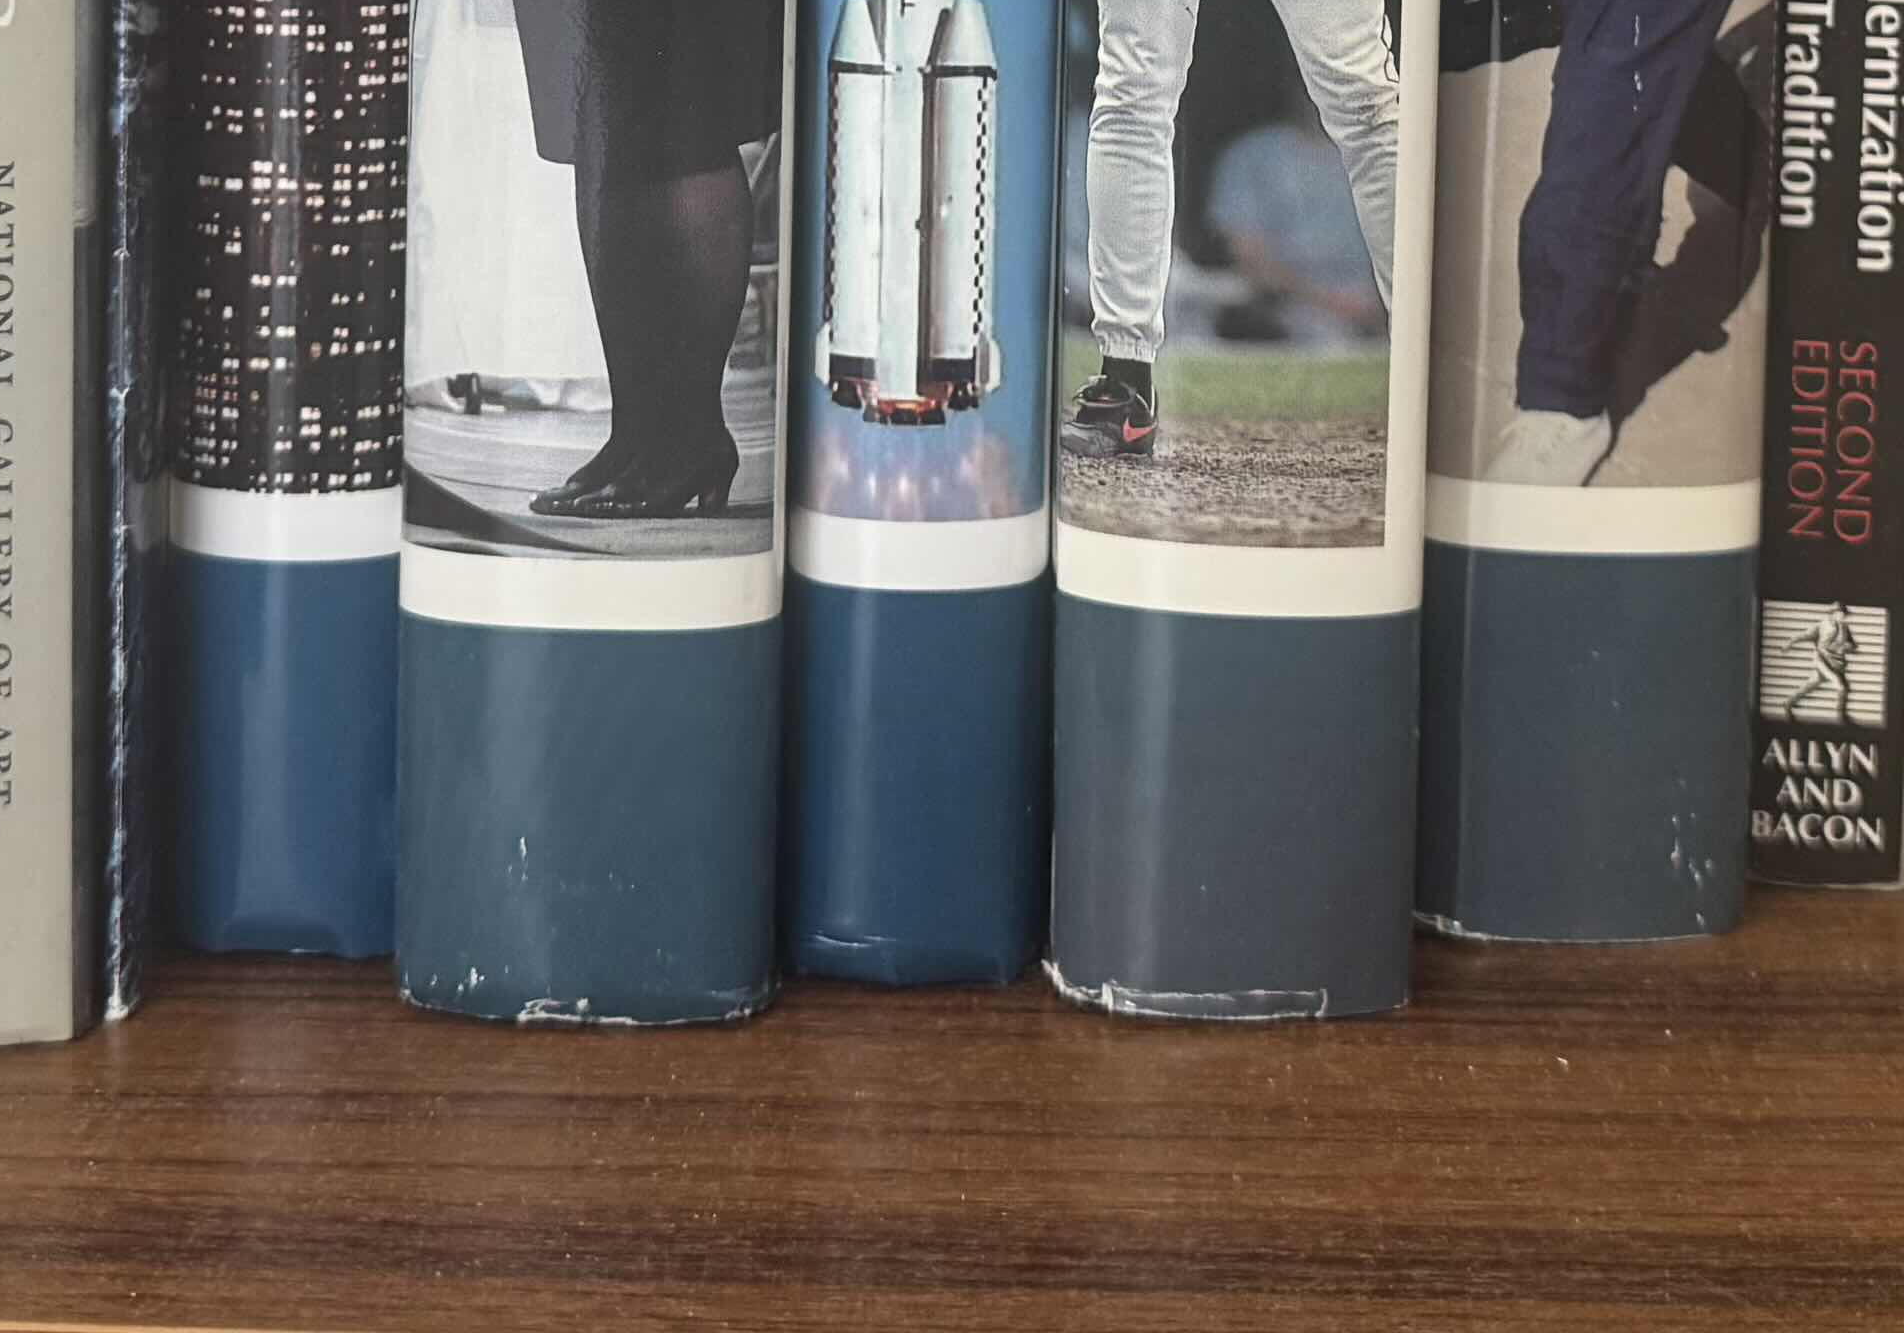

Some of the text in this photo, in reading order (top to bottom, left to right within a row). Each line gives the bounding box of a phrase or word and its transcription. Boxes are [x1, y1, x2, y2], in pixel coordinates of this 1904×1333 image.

[1786, 337, 1830, 541] EDITION
[1831, 339, 1879, 547] SECOND
[1761, 738, 1878, 774] ALLYN
[1776, 776, 1863, 809] AND
[1751, 810, 1886, 853] BACON
